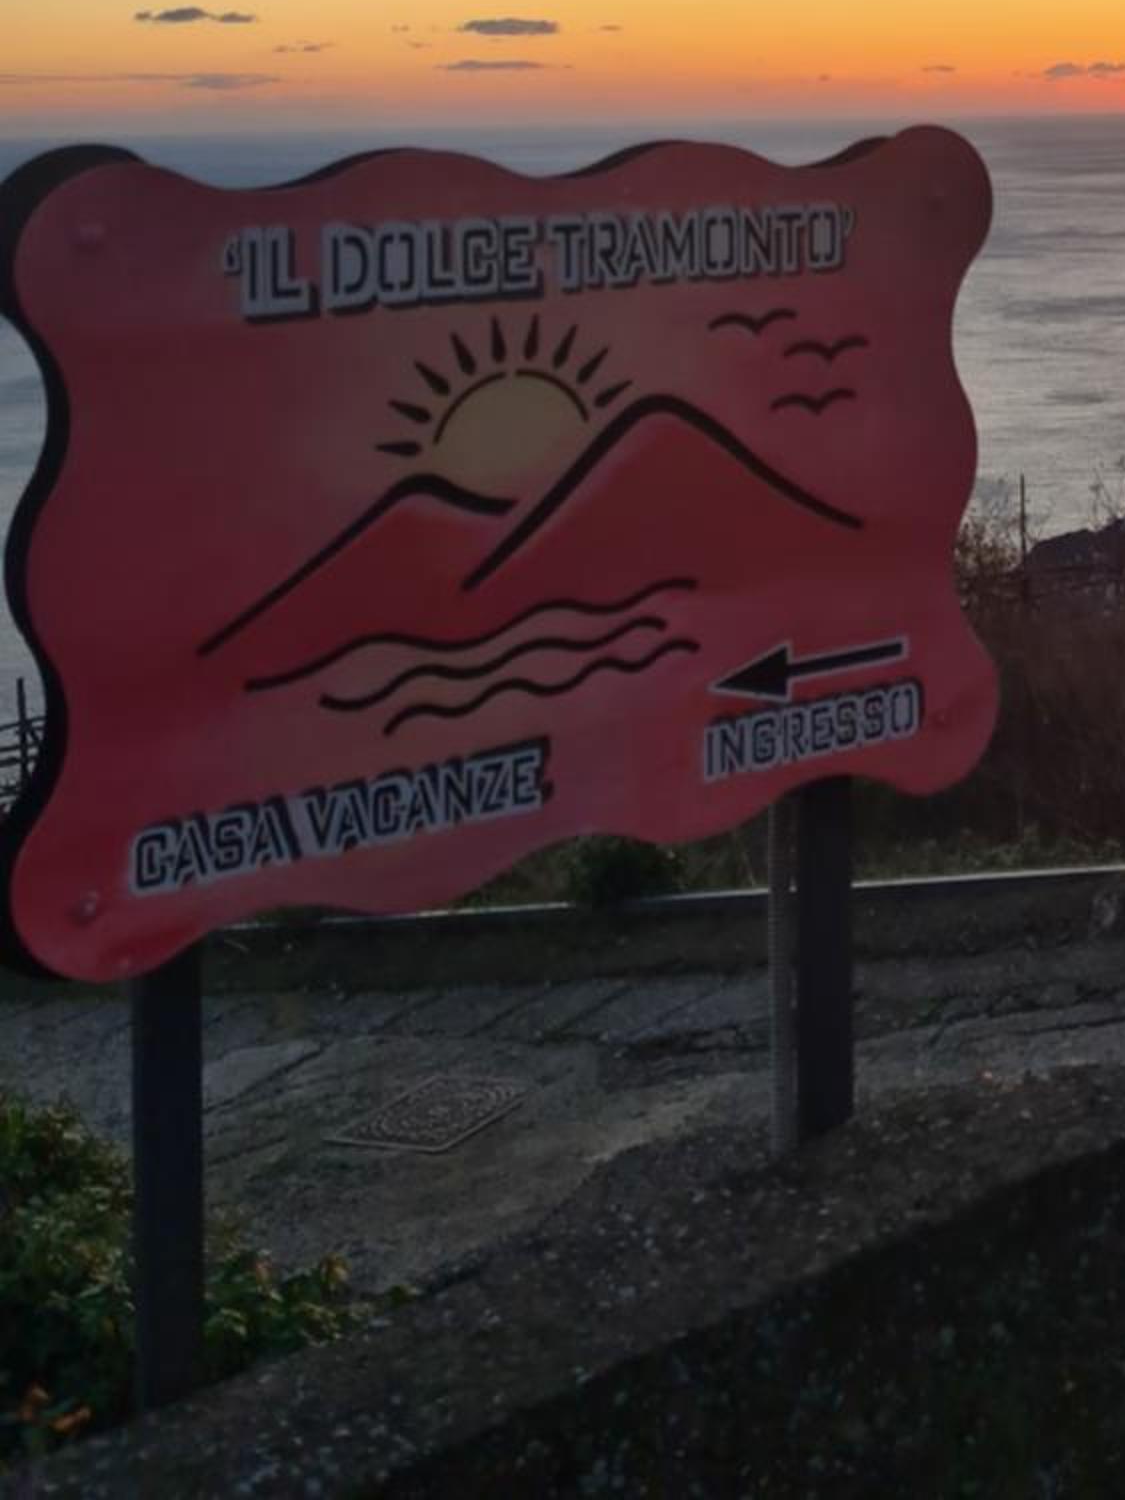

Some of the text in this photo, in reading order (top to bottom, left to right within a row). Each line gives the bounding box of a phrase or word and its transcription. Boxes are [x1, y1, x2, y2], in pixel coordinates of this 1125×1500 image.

[325, 217, 539, 307] DOLCE
[703, 682, 920, 780] INGRESSO
[130, 748, 544, 893] CASA VACANZE
